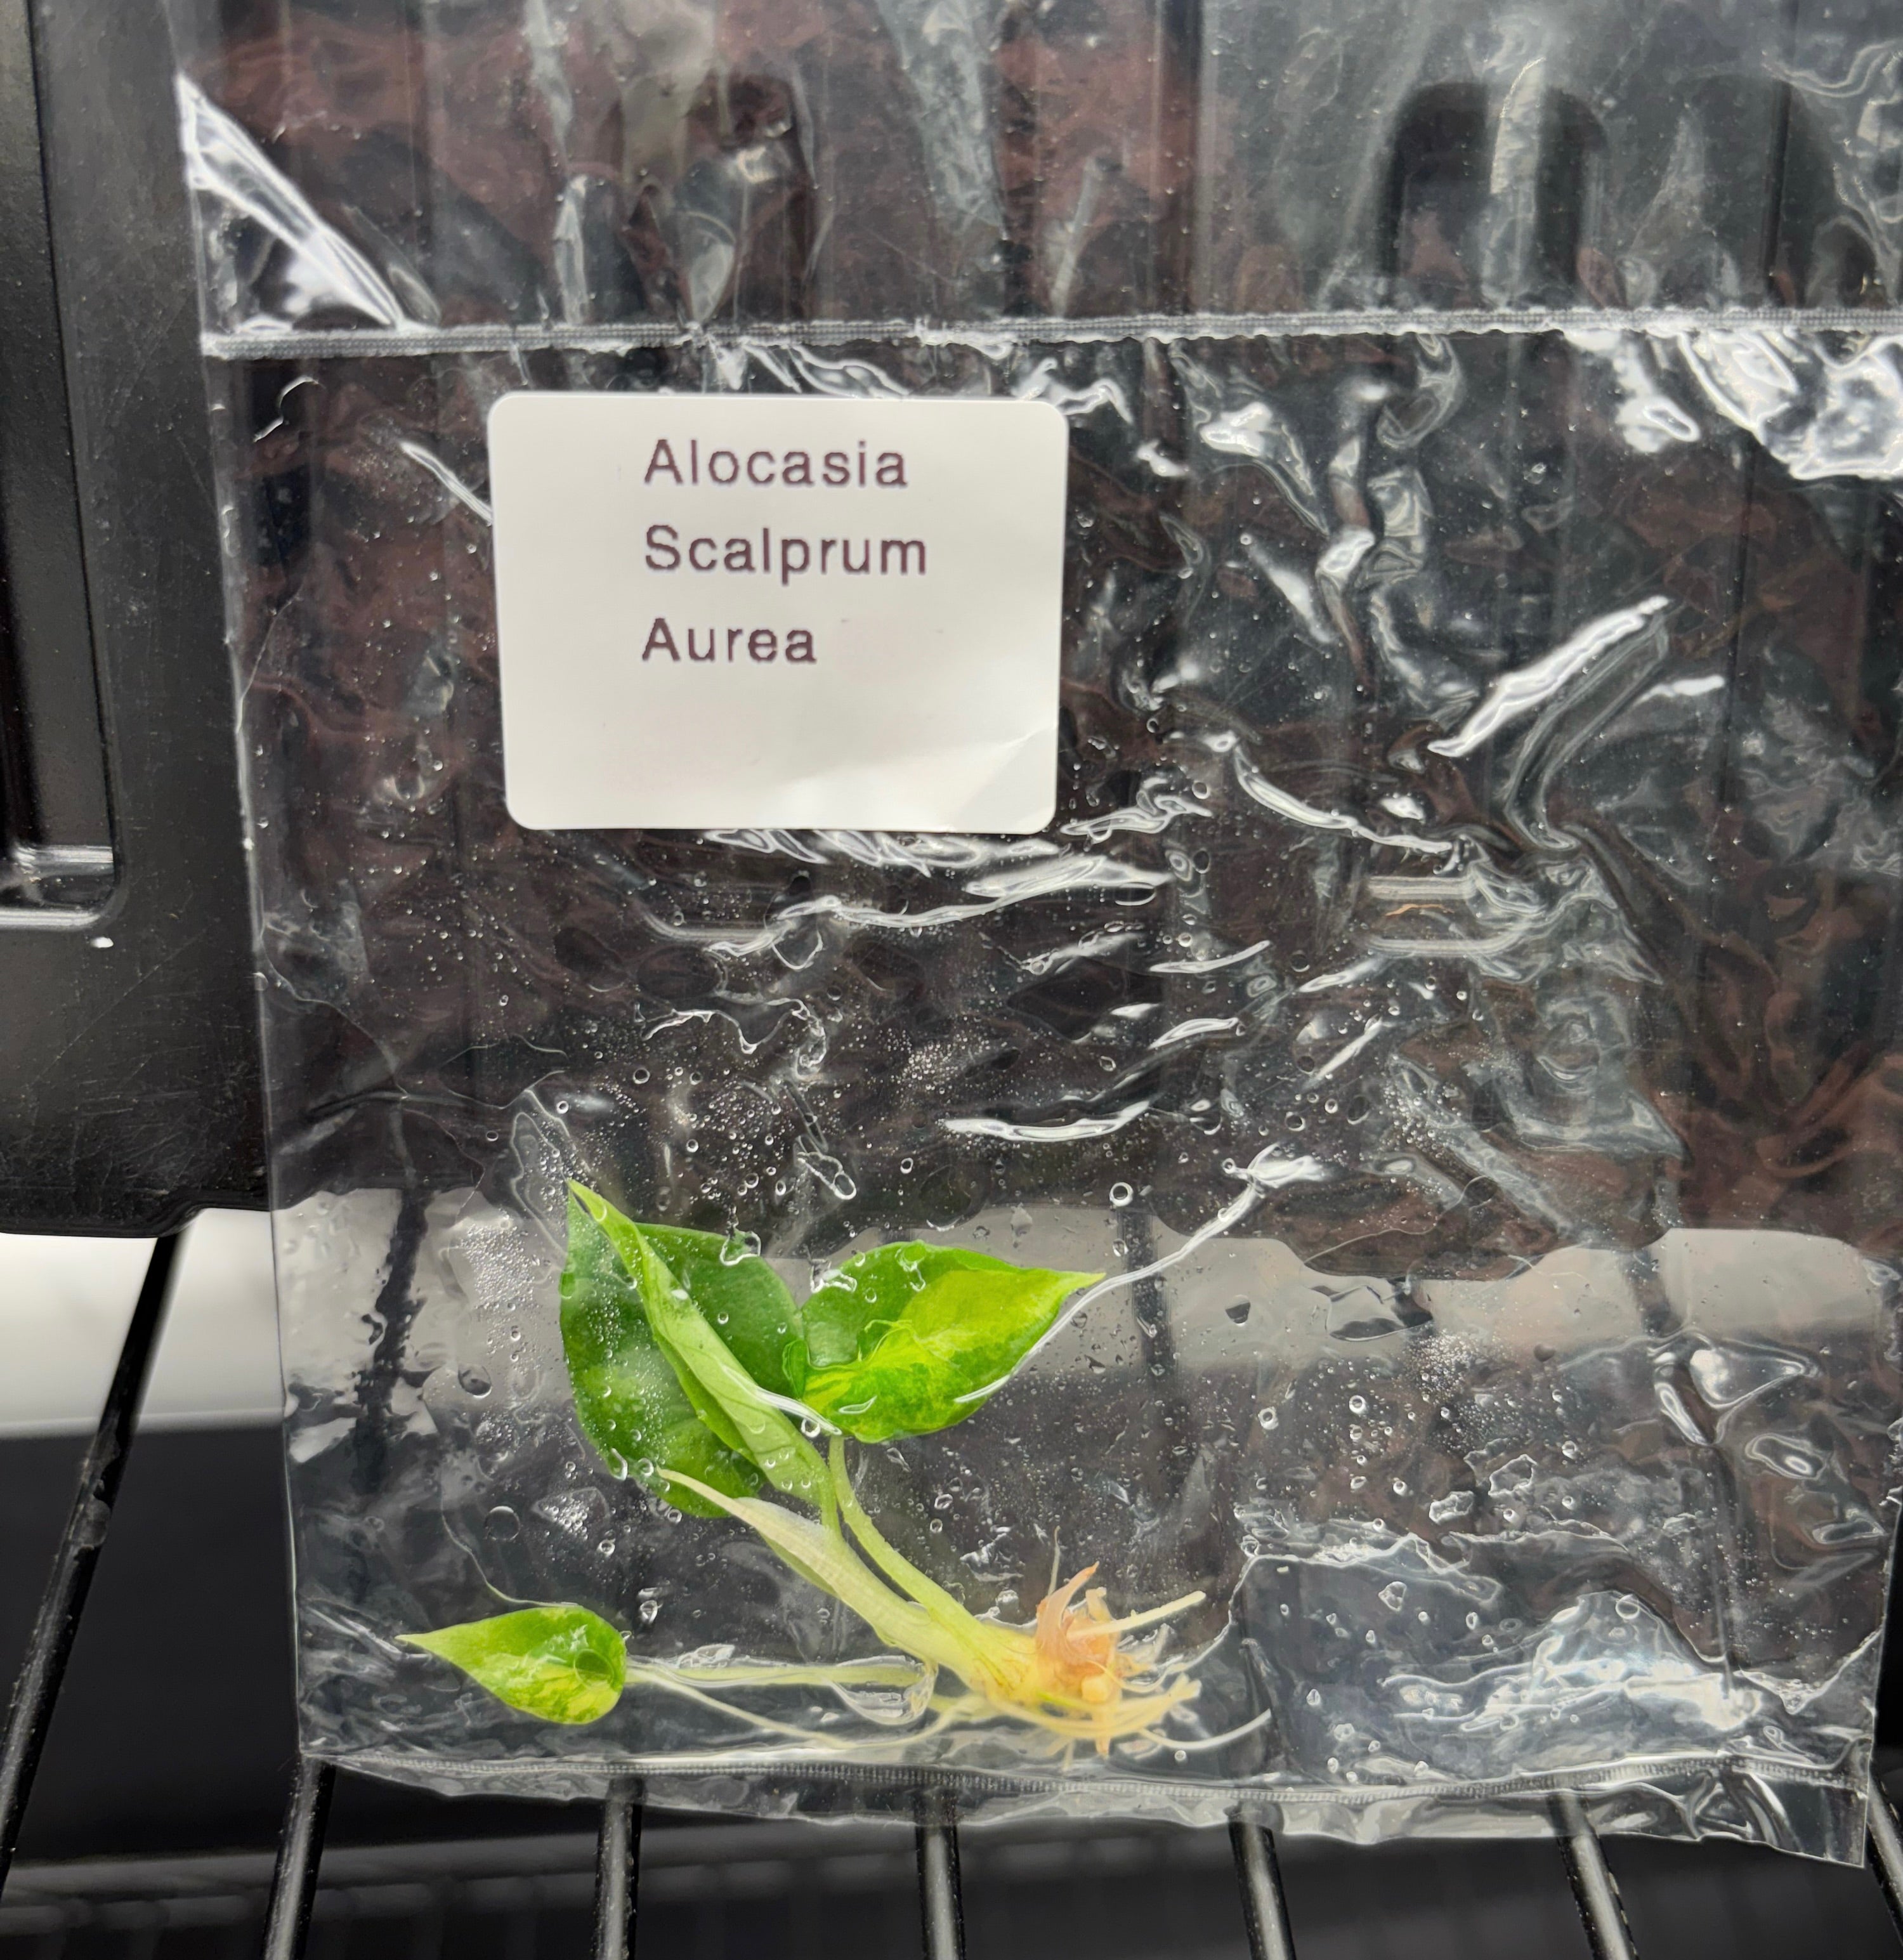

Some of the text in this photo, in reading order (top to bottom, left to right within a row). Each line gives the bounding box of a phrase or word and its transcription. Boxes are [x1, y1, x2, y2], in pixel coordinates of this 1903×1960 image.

[643, 438, 908, 487] Alocasia
[644, 524, 926, 586] Scalprum
[641, 617, 817, 665] Aurea
